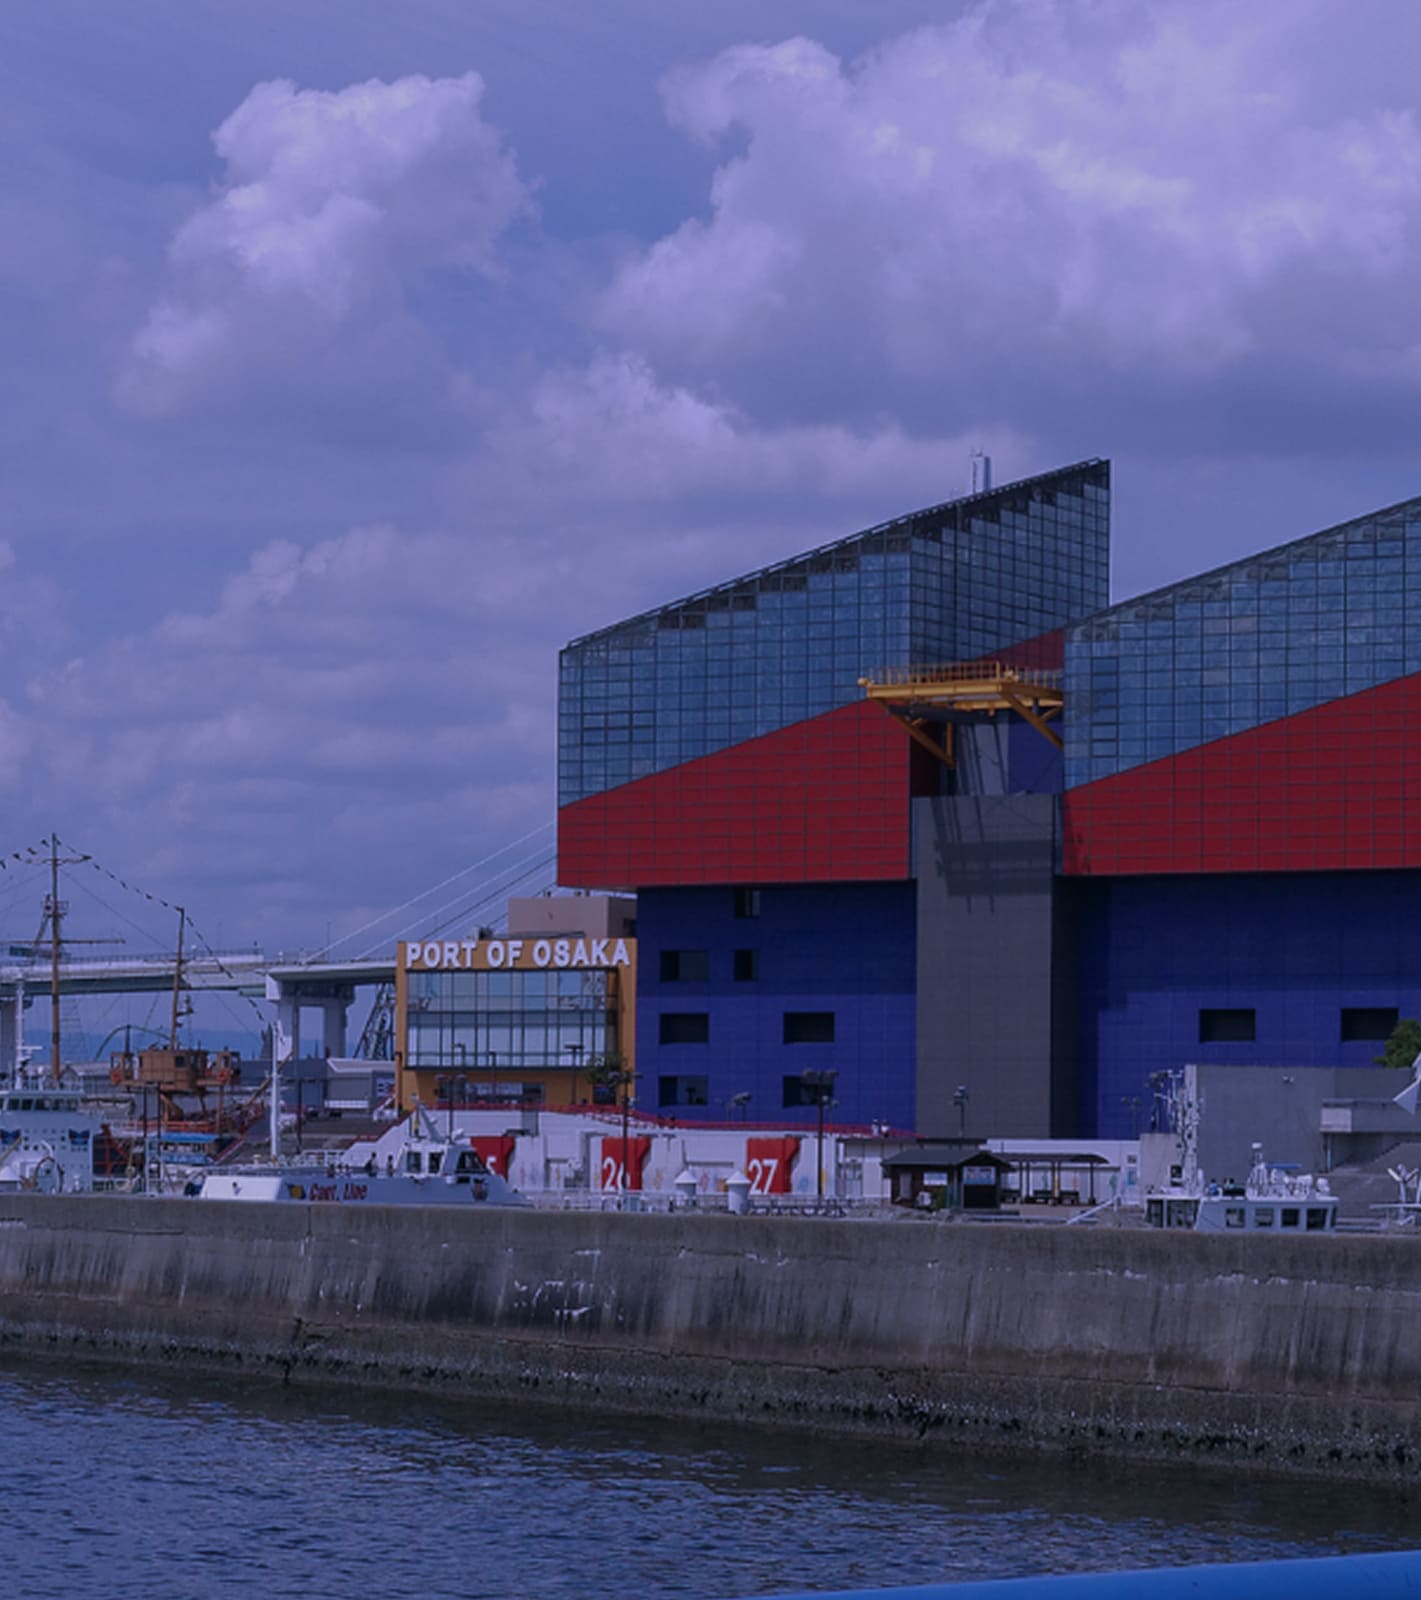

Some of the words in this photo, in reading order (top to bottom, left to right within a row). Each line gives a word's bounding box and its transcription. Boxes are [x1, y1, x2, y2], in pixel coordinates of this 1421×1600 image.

[405, 940, 477, 968] PORT
[486, 940, 523, 967] OF
[532, 938, 630, 967] OSAKA
[748, 1158, 778, 1195] 27
